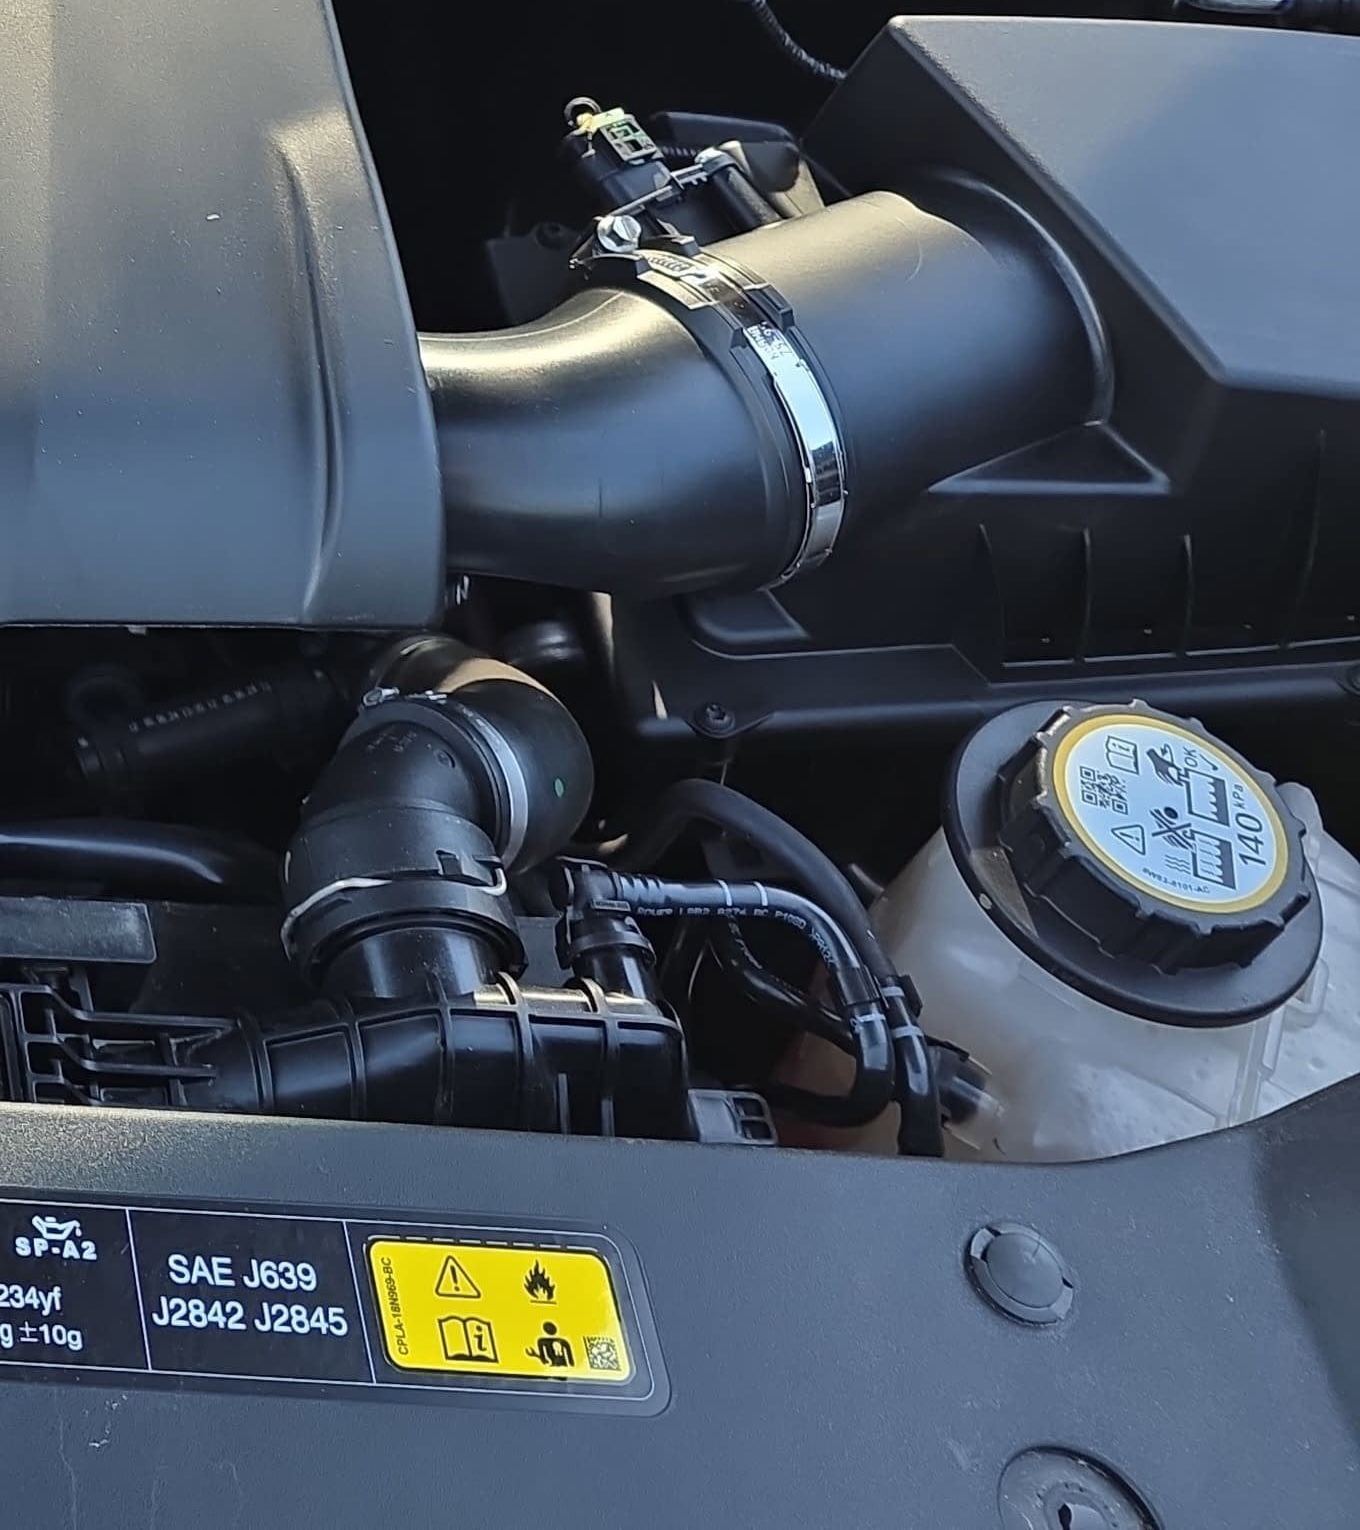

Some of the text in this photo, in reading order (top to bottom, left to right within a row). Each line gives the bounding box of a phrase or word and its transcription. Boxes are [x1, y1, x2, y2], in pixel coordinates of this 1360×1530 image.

[1183, 746, 1199, 768] OK
[1232, 784, 1267, 866] 140 kPa
[15, 1237, 98, 1261] SP-A2
[168, 1254, 317, 1291] SAE J639
[152, 1296, 348, 1336] J2842 J2845
[18, 1321, 83, 1351] ±10g
